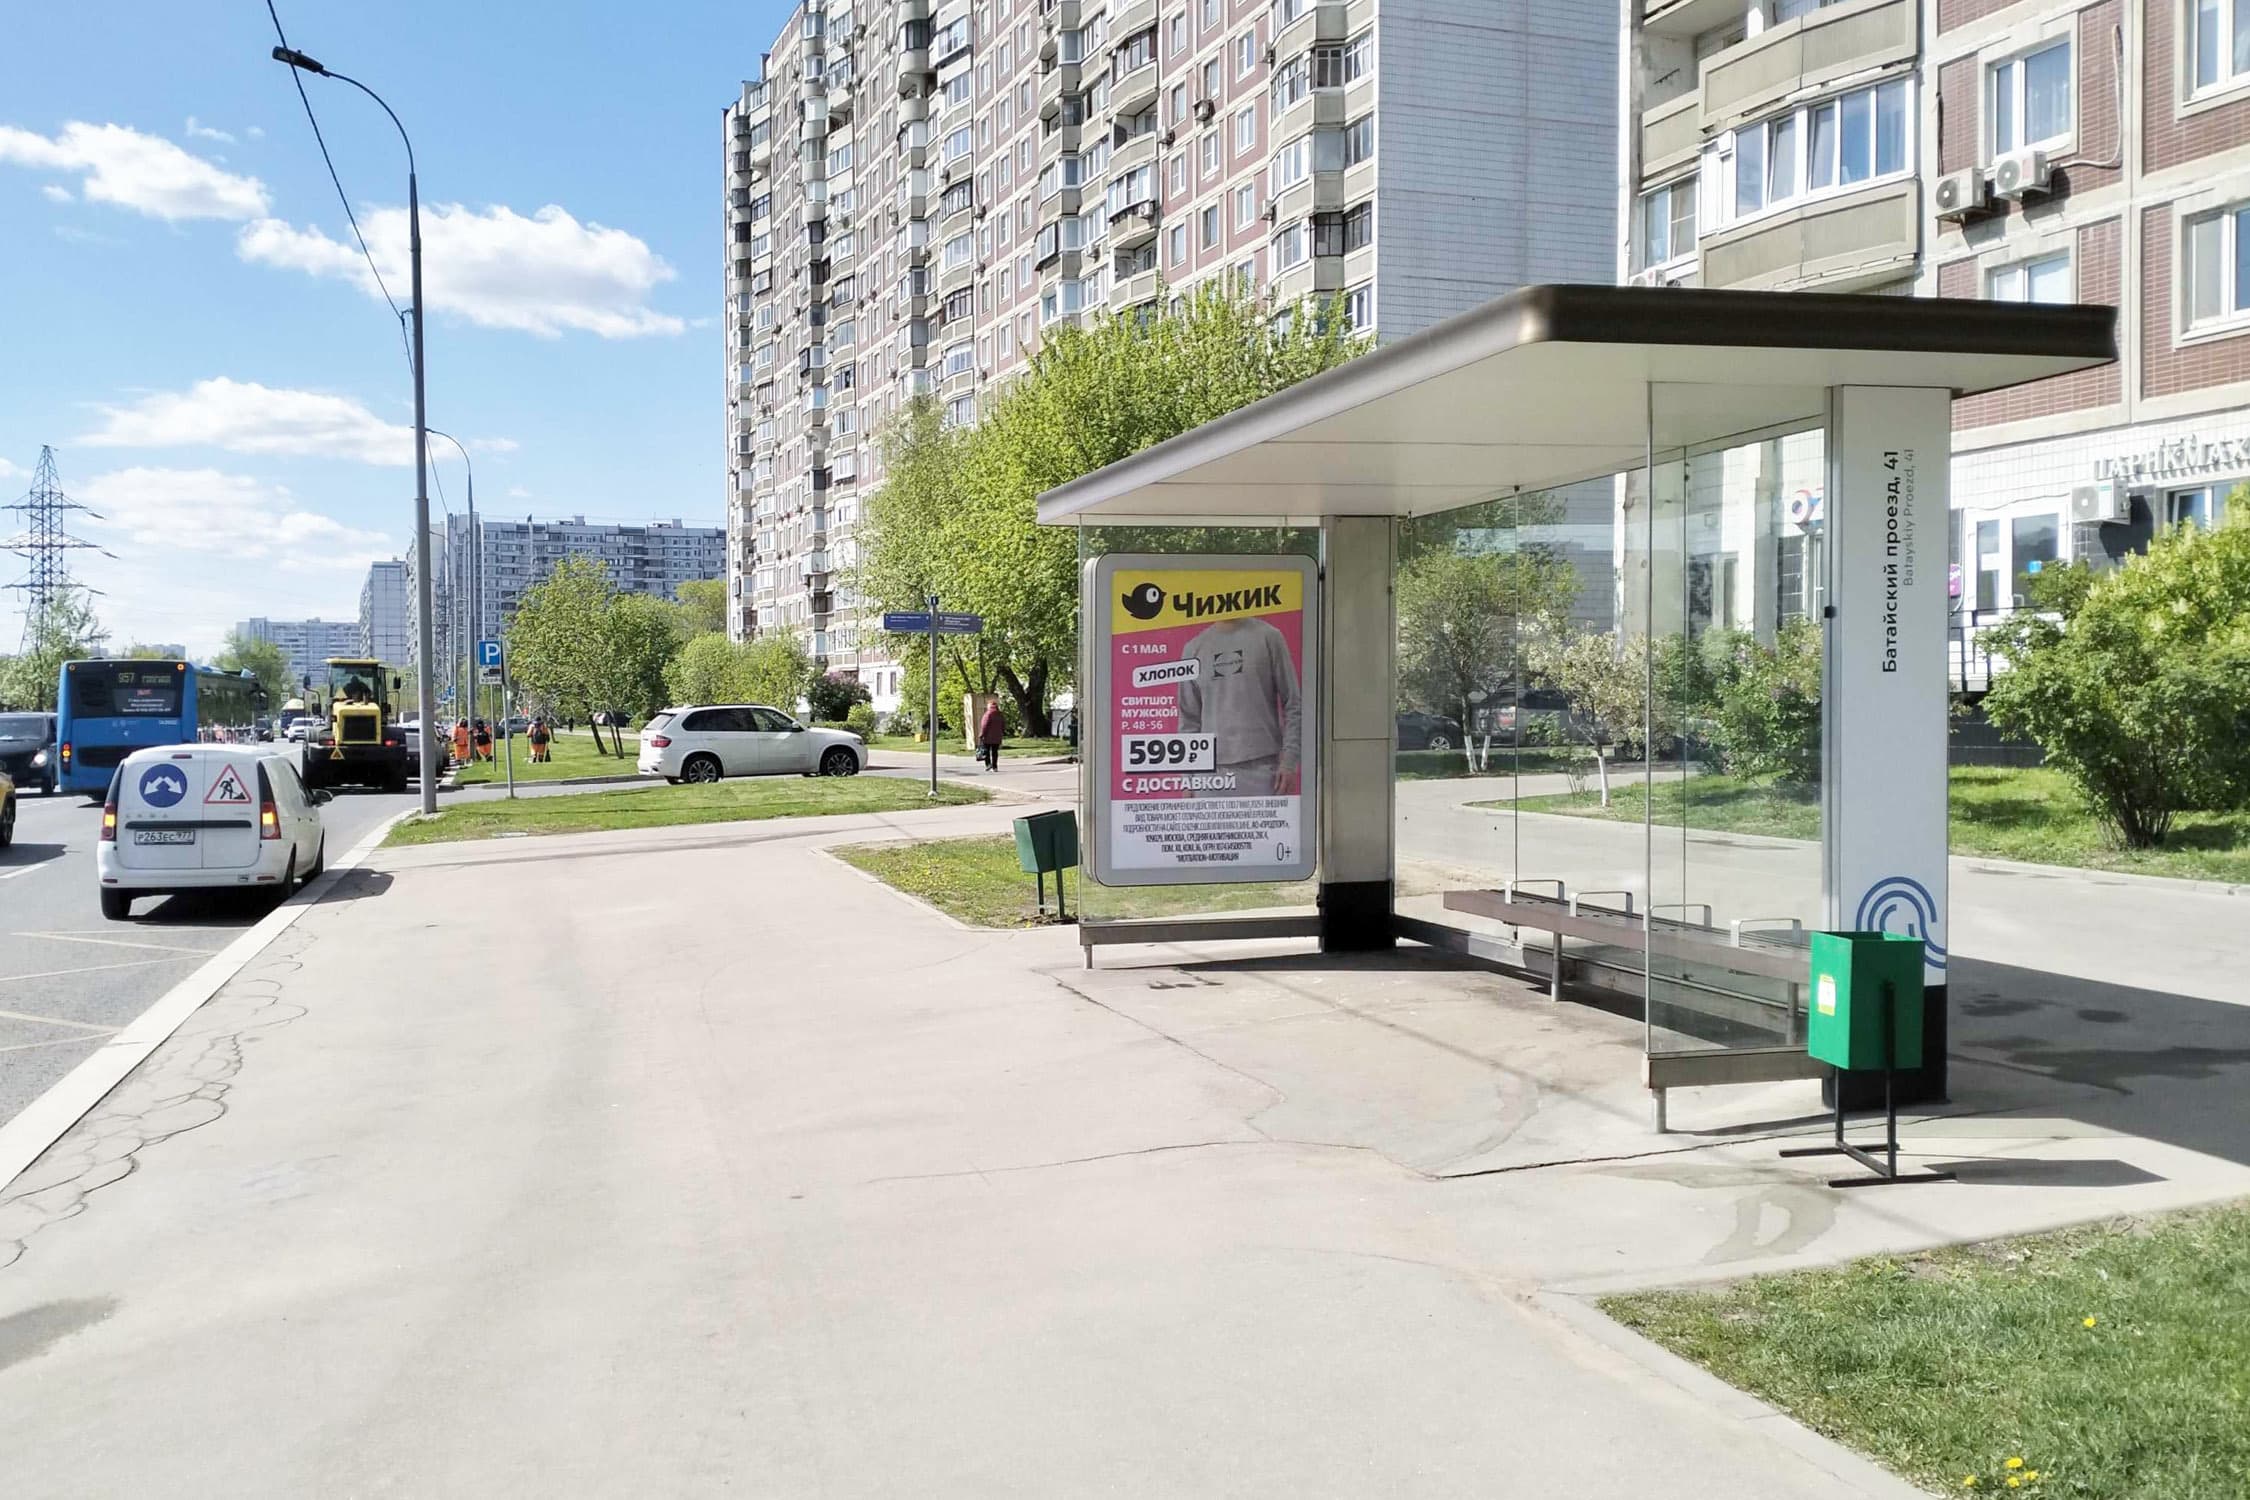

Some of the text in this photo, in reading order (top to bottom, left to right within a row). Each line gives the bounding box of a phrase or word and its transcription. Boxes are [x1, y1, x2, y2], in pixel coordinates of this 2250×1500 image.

[1903, 449, 1916, 586] Batayskiy Proezd, 41
[1883, 451, 1901, 673] Батайский проезд, 41
[1121, 644, 1168, 654] С 1 МАЯ
[1138, 664, 1195, 683] ХЛОПОК
[1121, 696, 1175, 706] СВИТШОТ
[1121, 706, 1178, 718] МУЖСКОЙ
[1121, 720, 1164, 730] Р. 48-56
[1129, 740, 1209, 765] 599 00
[1122, 772, 1237, 794] С ДОСТАВКОЙ
[1276, 842, 1292, 861] 0+
